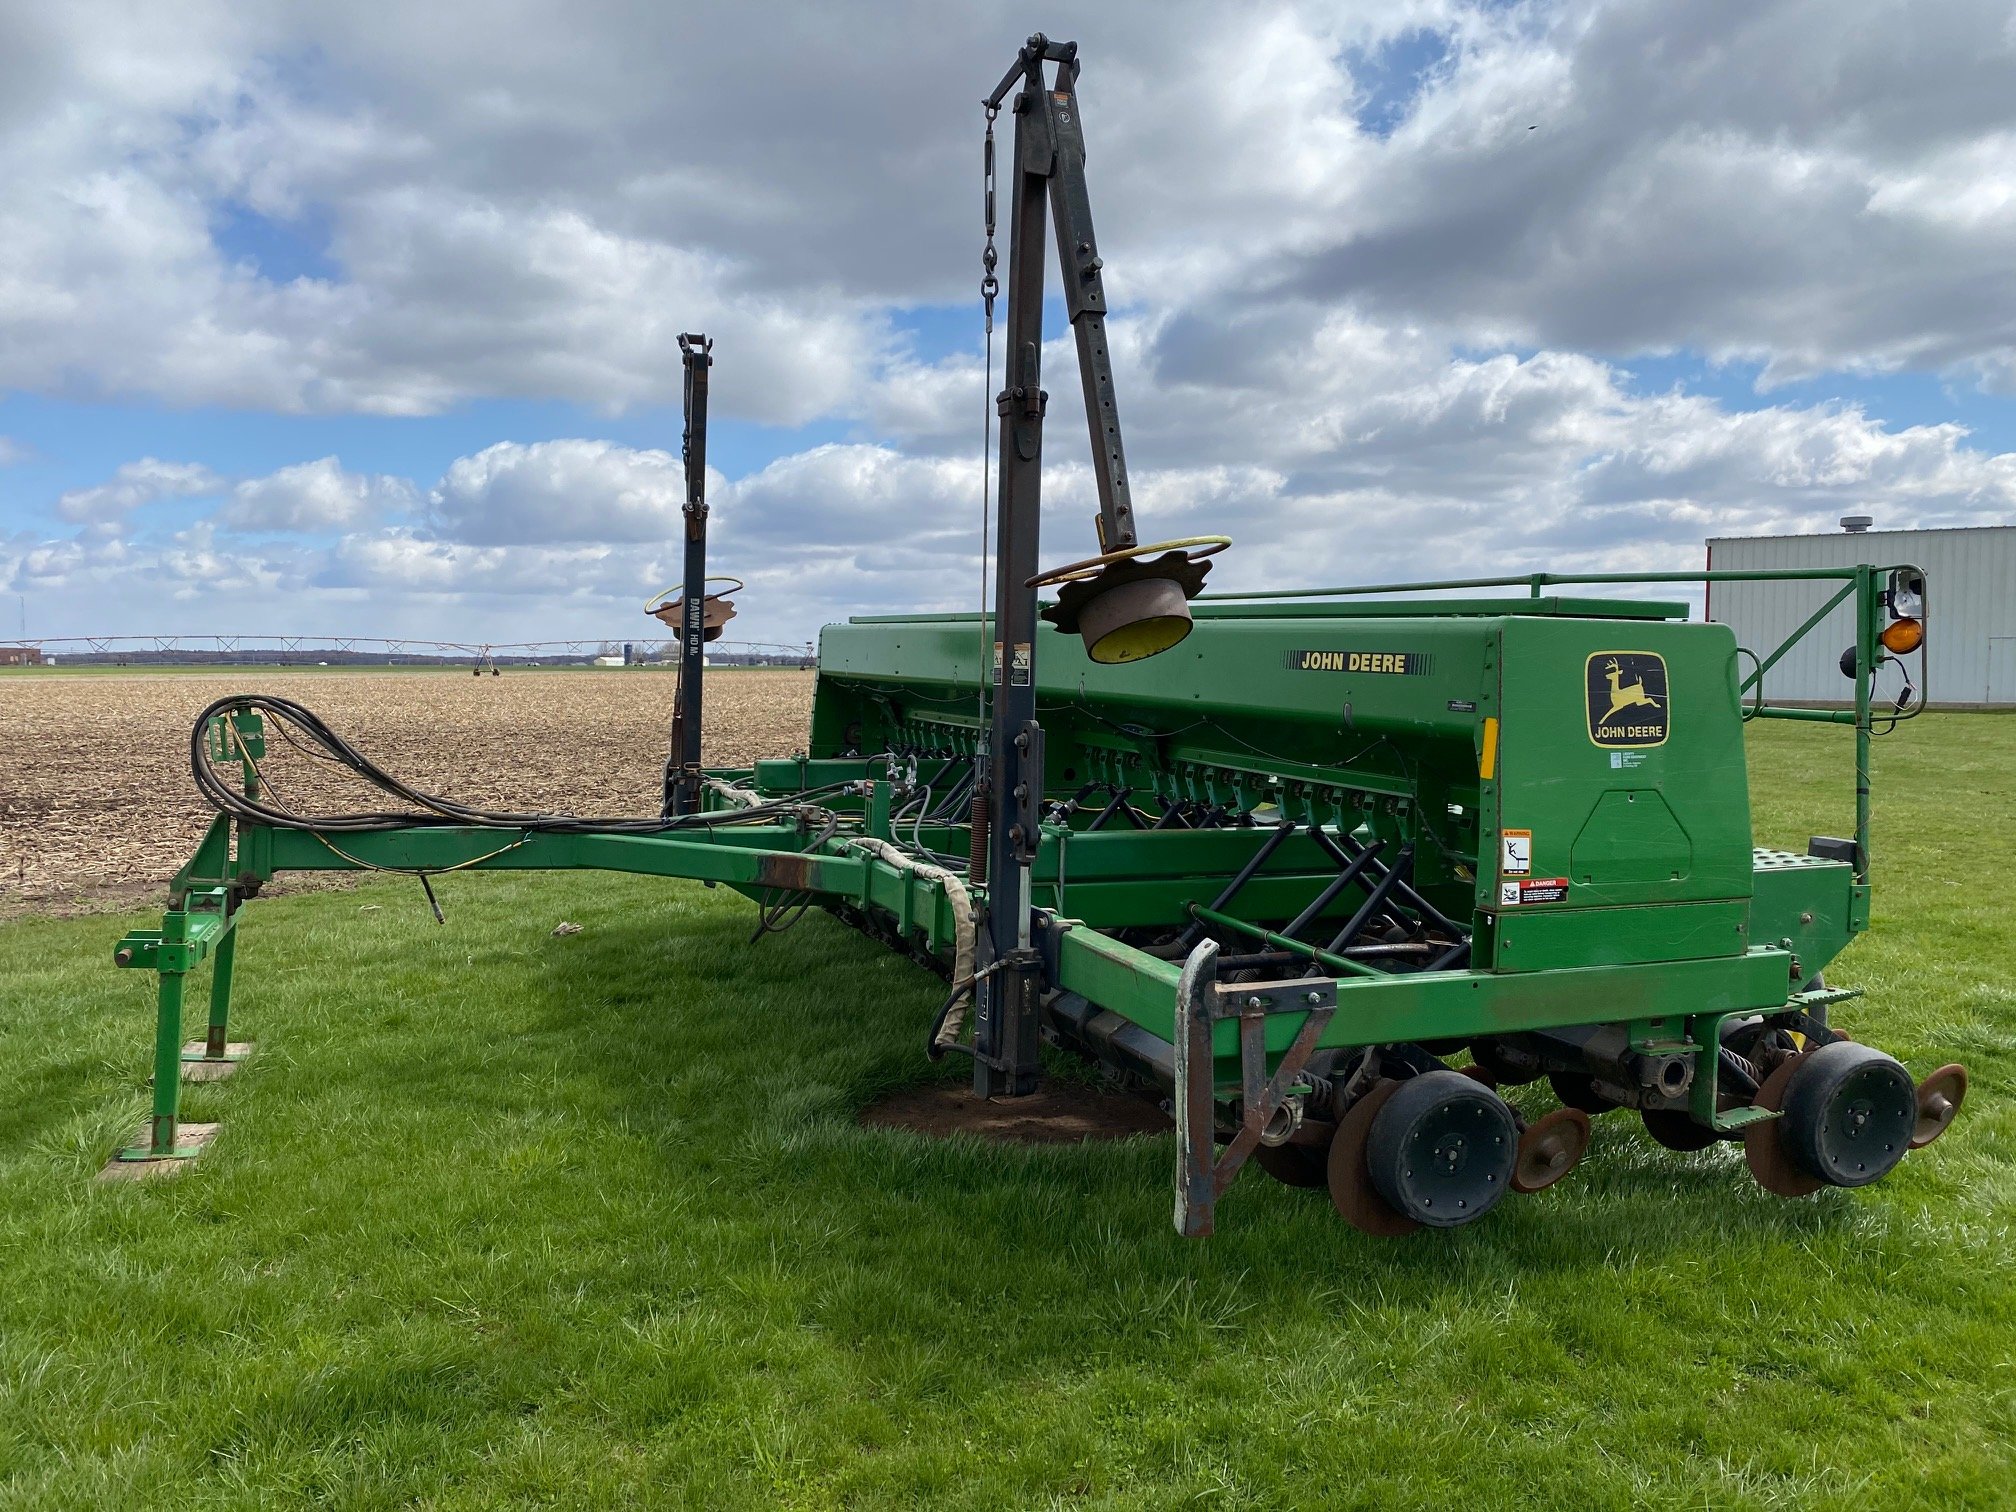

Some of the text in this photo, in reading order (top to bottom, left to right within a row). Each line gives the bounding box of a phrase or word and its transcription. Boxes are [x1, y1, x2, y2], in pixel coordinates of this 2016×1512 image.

[690, 597, 700, 629] DAWN
[1302, 652, 1406, 673] JOHN DEERE
[1595, 725, 1663, 738] JOHN DEERE
